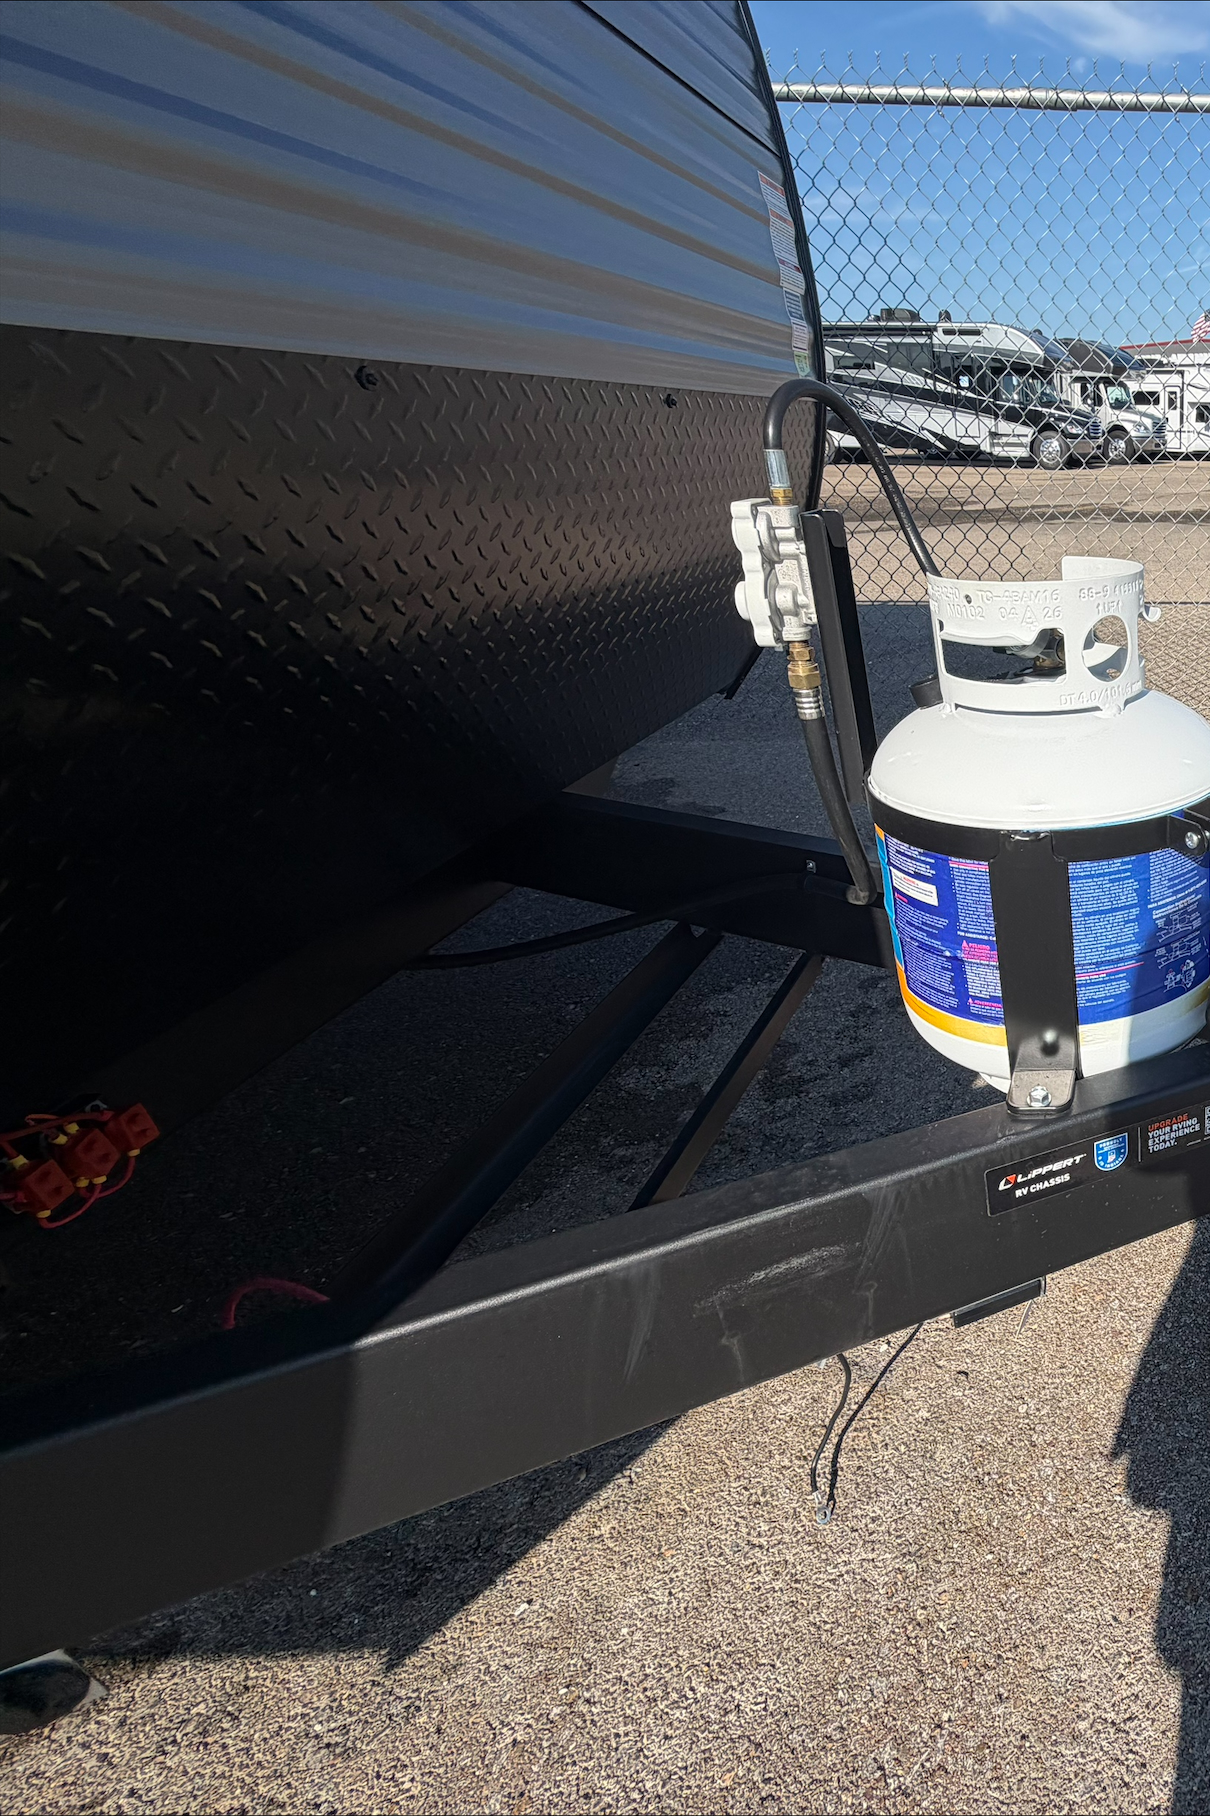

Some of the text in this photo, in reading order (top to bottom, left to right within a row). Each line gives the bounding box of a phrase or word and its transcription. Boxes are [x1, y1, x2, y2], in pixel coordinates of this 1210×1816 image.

[1148, 1113, 1189, 1132] UPGRADE
[1148, 1117, 1198, 1139] YOUR RVING
[1148, 1123, 1201, 1147] EXPERIENCE
[1148, 1139, 1178, 1154] TODAY.
[1015, 1173, 1071, 1198] RV CHASSIS
